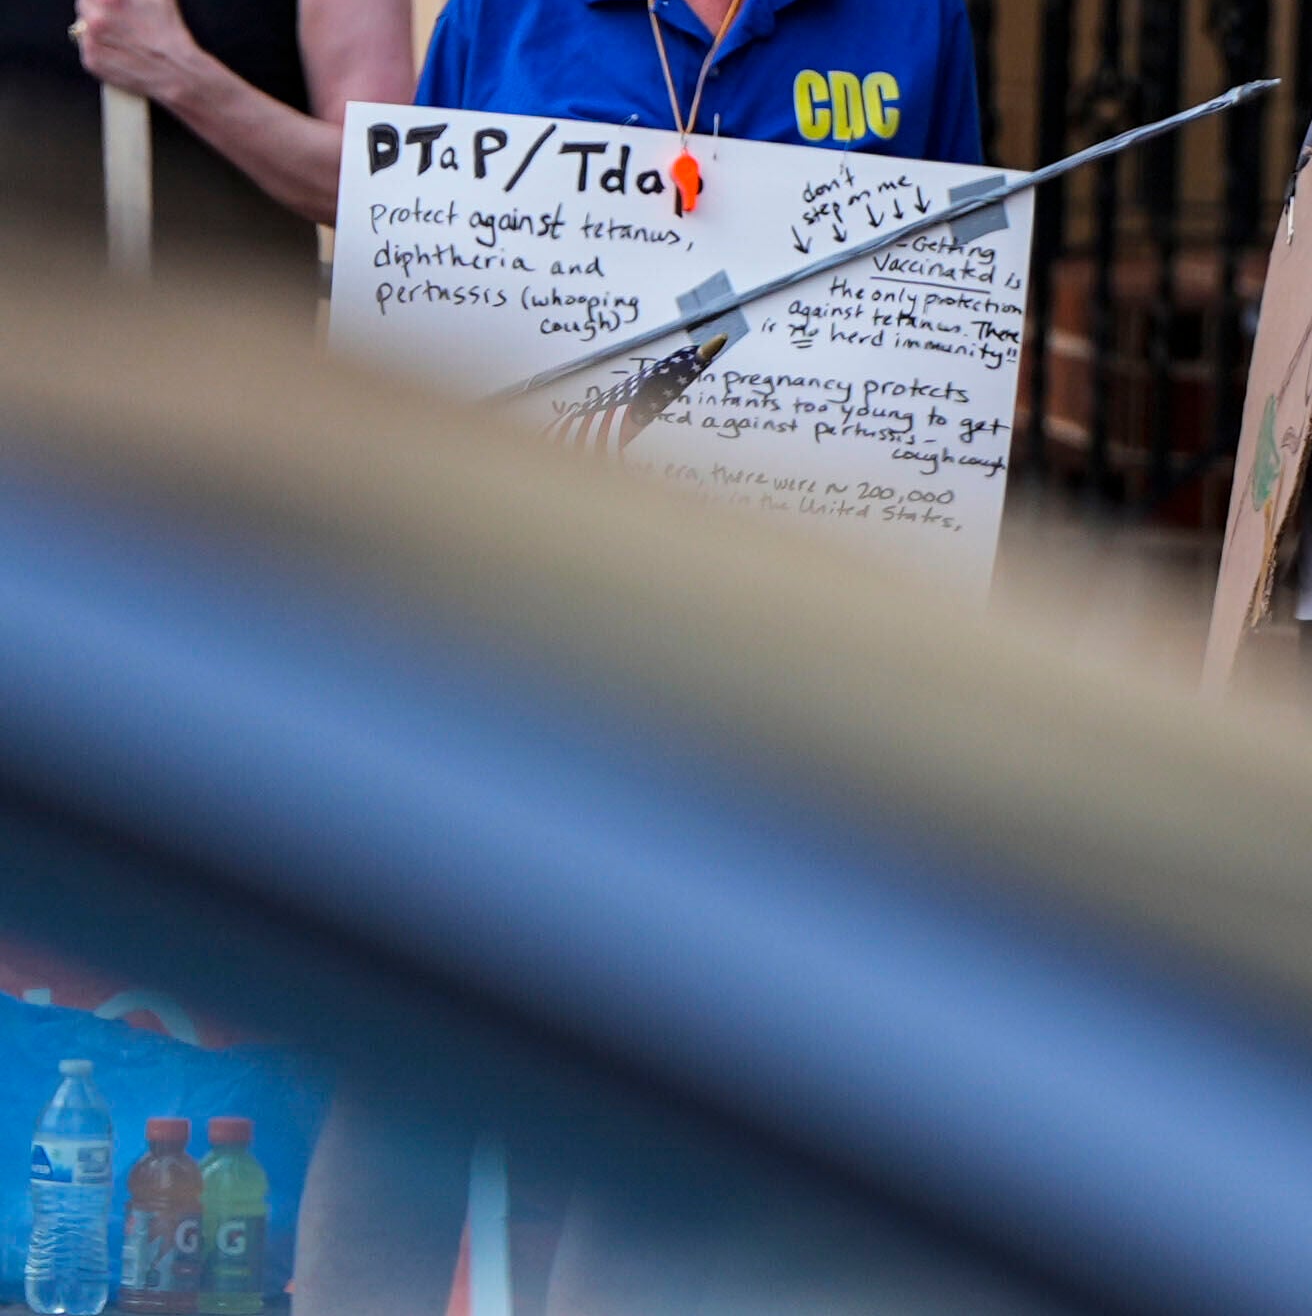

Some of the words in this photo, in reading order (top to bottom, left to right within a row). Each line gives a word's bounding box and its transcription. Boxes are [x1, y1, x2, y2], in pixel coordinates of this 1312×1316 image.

[793, 69, 900, 141] CDC
[803, 166, 855, 203] don't
[803, 201, 844, 225] step
[878, 174, 913, 194] me
[370, 197, 459, 233] protect
[469, 202, 566, 247] against
[373, 240, 535, 278] diphtheria
[550, 257, 605, 277] and
[830, 276, 864, 300] the
[872, 287, 917, 314] only
[924, 292, 1022, 316] protection
[1004, 274, 1021, 290] is
[521, 287, 639, 323] (whooping
[788, 300, 864, 326] against
[540, 310, 621, 341] cough)
[761, 318, 776, 333] is
[830, 323, 884, 348] herd
[722, 370, 852, 404] pregnancy
[863, 378, 970, 408] protects
[698, 392, 782, 412] infants
[793, 397, 828, 413] too
[841, 405, 914, 433] young
[928, 406, 947, 426] to
[960, 418, 1011, 444] get
[701, 414, 799, 440] against
[711, 462, 769, 485] there
[773, 477, 816, 493] were
[892, 447, 954, 475] cough
[799, 494, 869, 518] United
[216, 1221, 247, 1255] G
